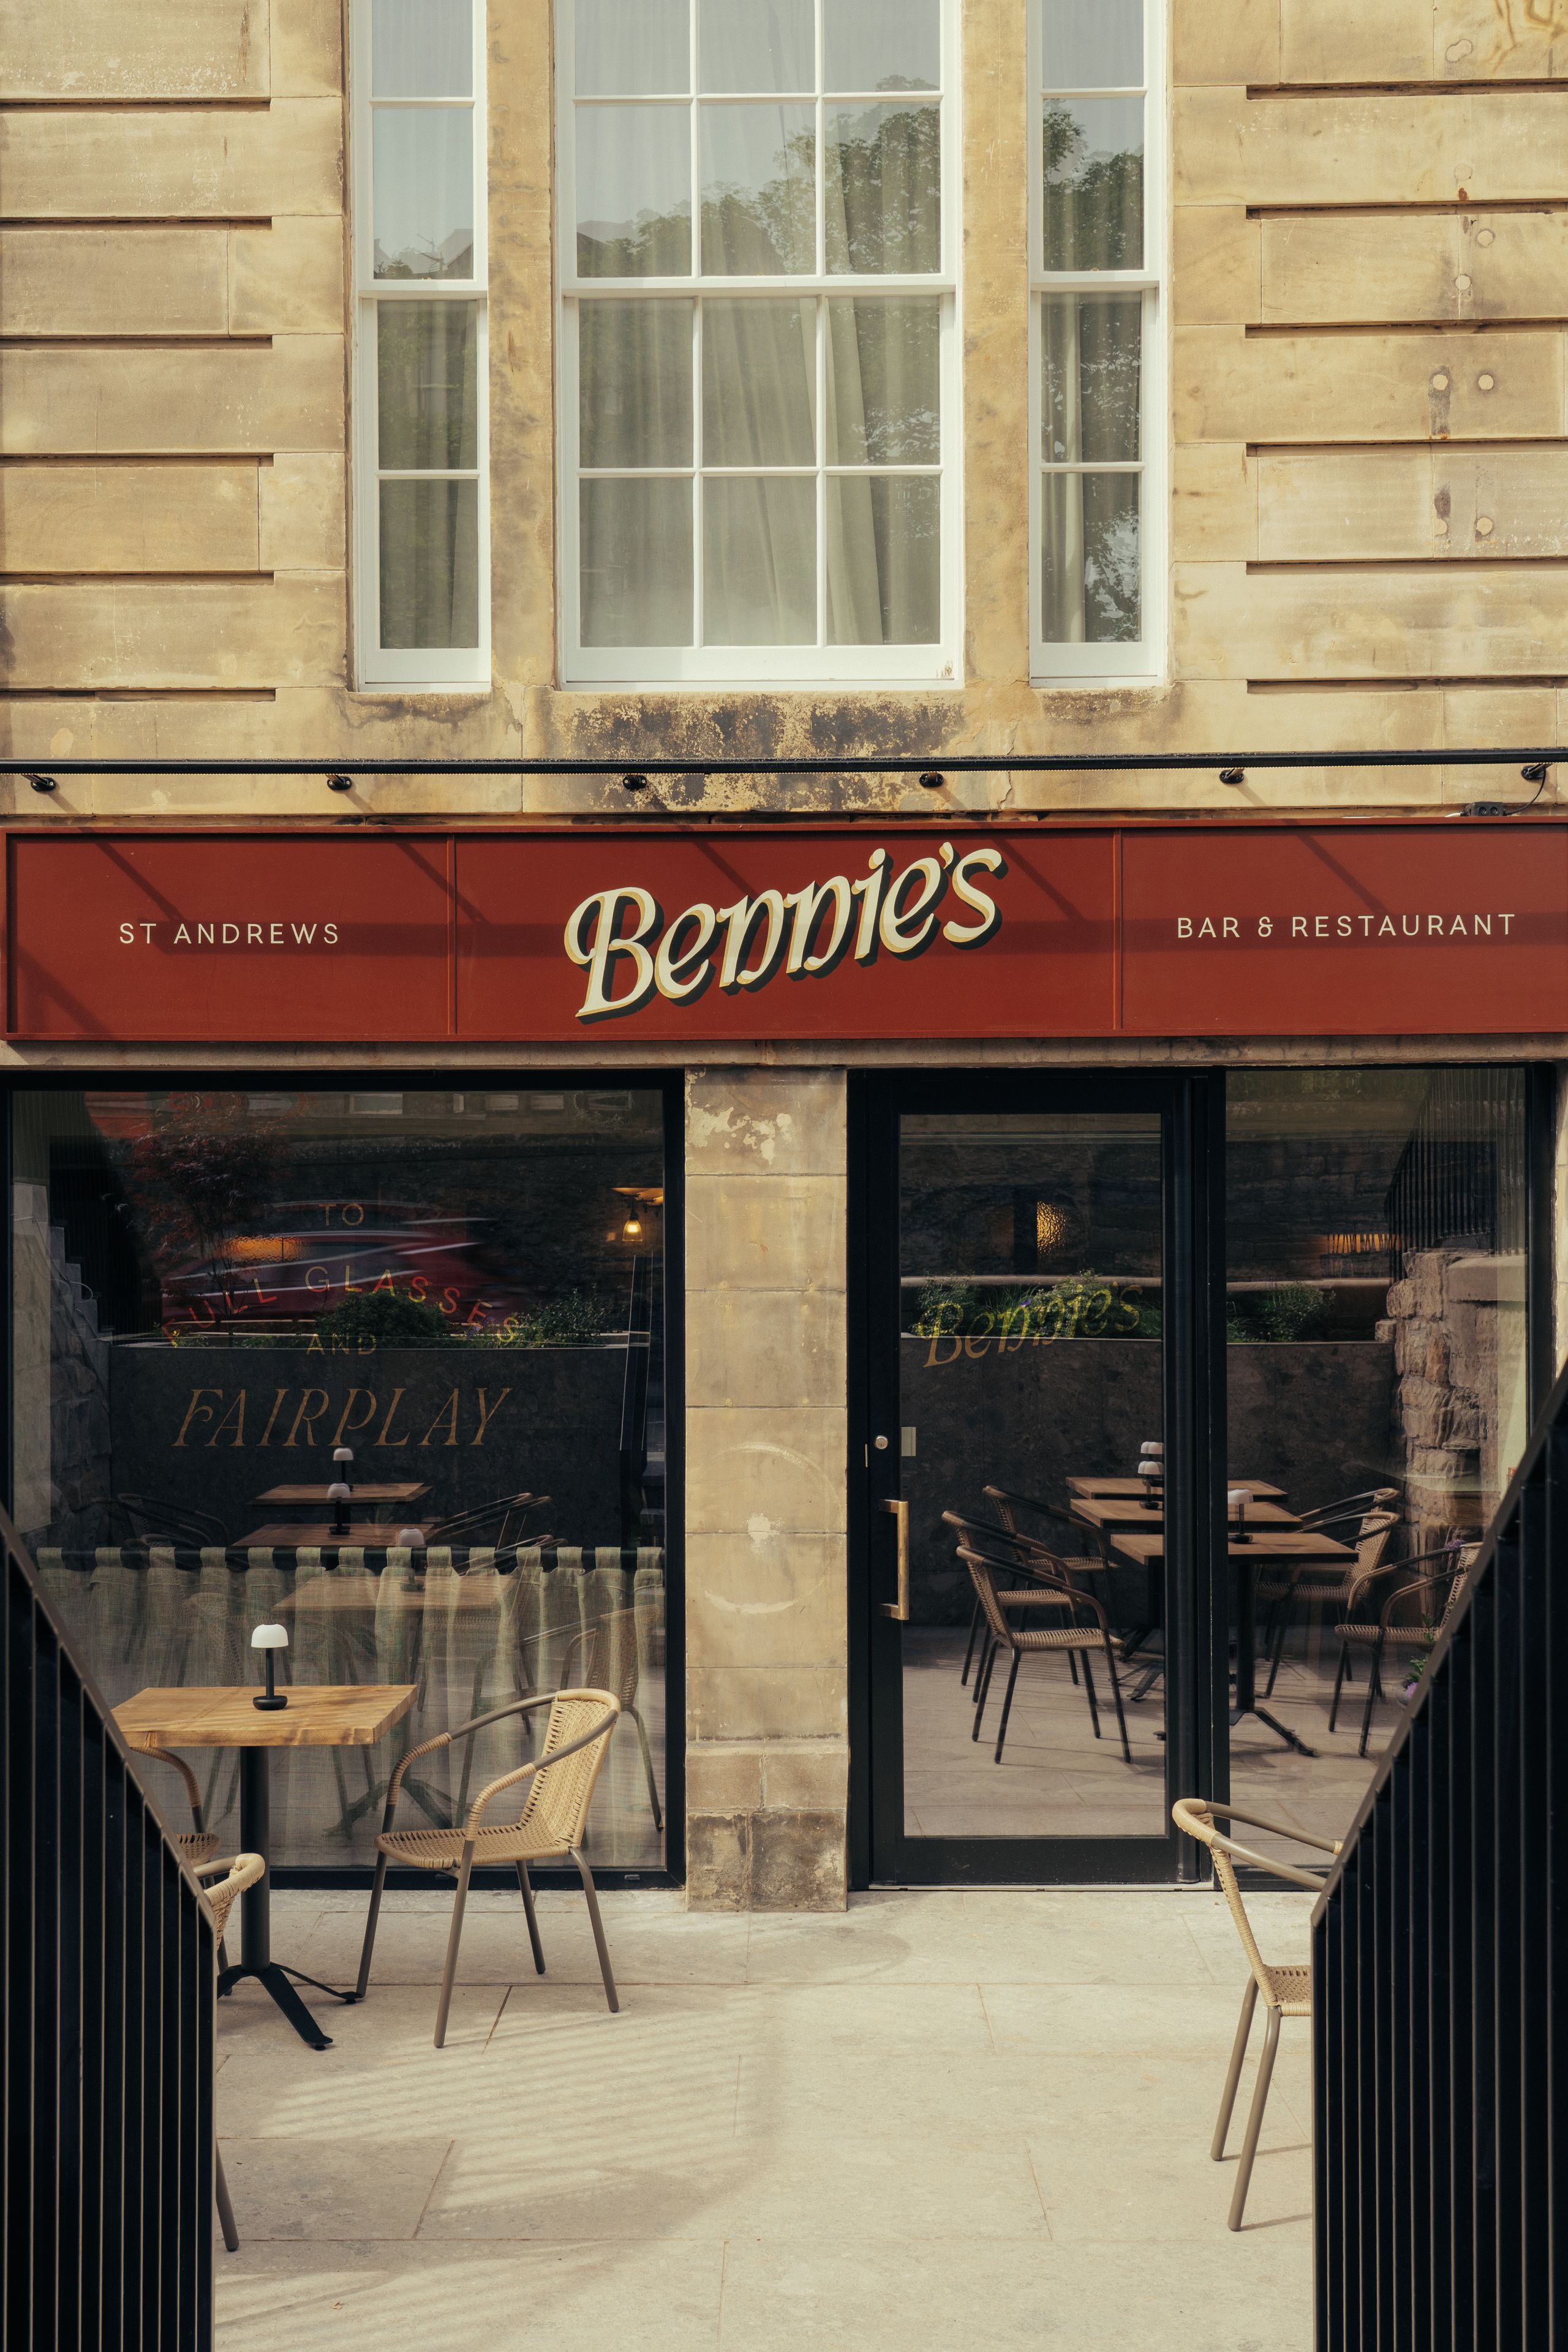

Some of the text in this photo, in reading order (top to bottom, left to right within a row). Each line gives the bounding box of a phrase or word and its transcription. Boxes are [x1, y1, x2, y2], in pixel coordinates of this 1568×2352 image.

[119, 922, 339, 944] ST ANDREWS
[564, 842, 1006, 1023] Bennie's
[1177, 913, 1516, 939] BAR & RESTAURANT
[318, 1202, 365, 1226] TO
[161, 1265, 520, 1349] FULL GLASSES
[916, 1280, 1144, 1368] Bennie's
[306, 1332, 377, 1356] AND
[171, 1387, 514, 1447] FAIRPLAY
